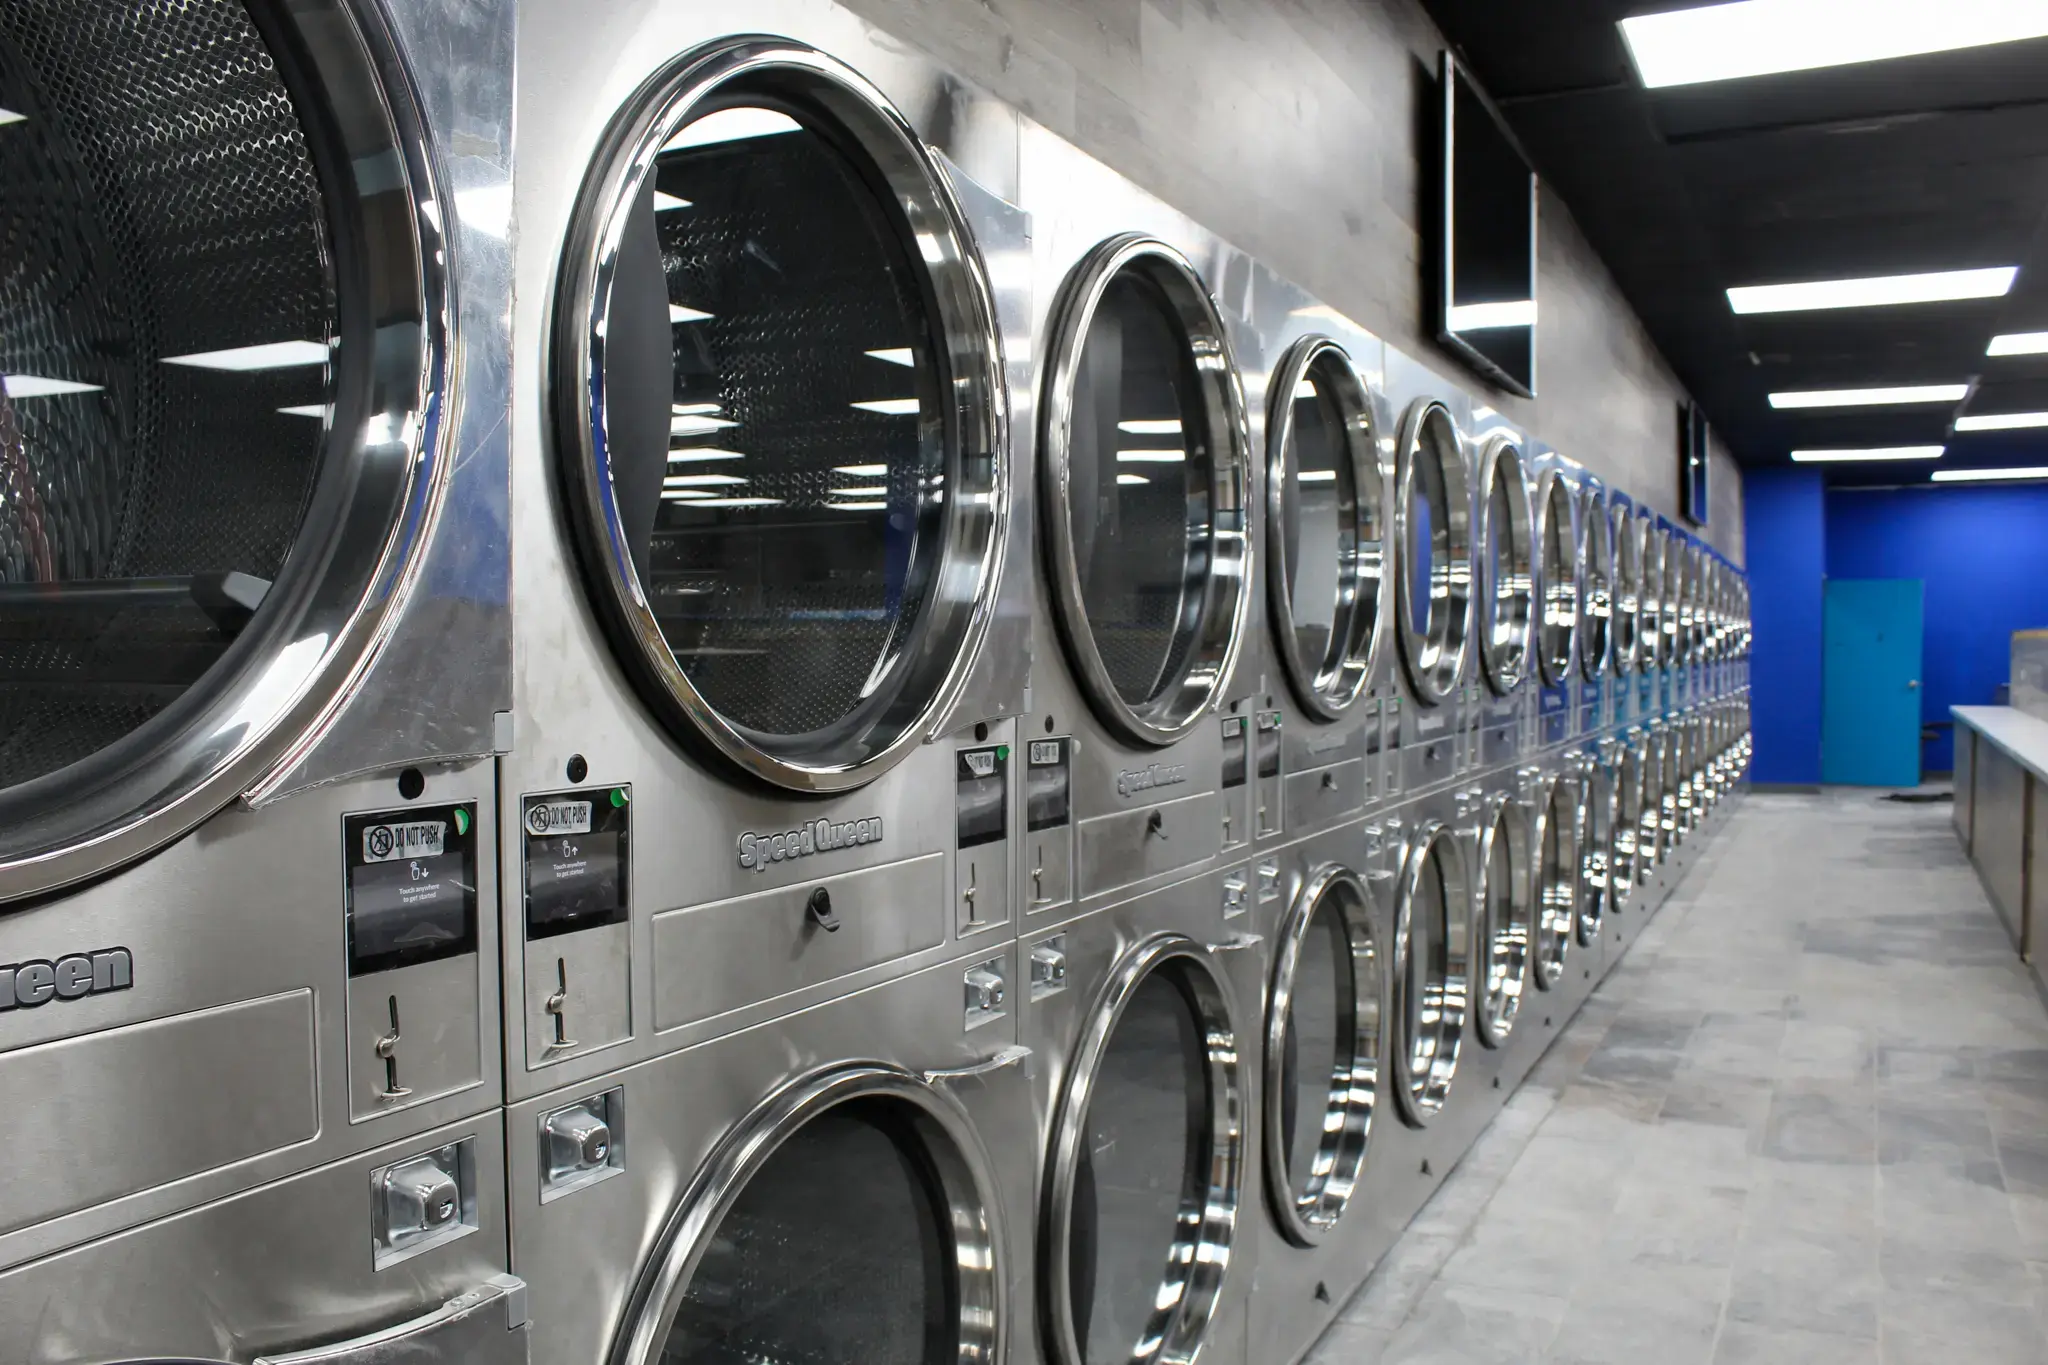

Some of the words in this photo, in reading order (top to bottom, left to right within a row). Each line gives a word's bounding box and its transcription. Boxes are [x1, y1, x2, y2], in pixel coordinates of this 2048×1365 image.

[561, 806, 571, 825] NOT
[572, 806, 587, 824] PUSH
[395, 827, 405, 848] DO
[406, 826, 419, 847] NOT
[420, 825, 439, 845] PUSH
[399, 887, 415, 895] Touch
[416, 884, 440, 893] anywhere
[403, 895, 410, 903] to
[410, 894, 418, 903] get
[419, 892, 437, 900] started
